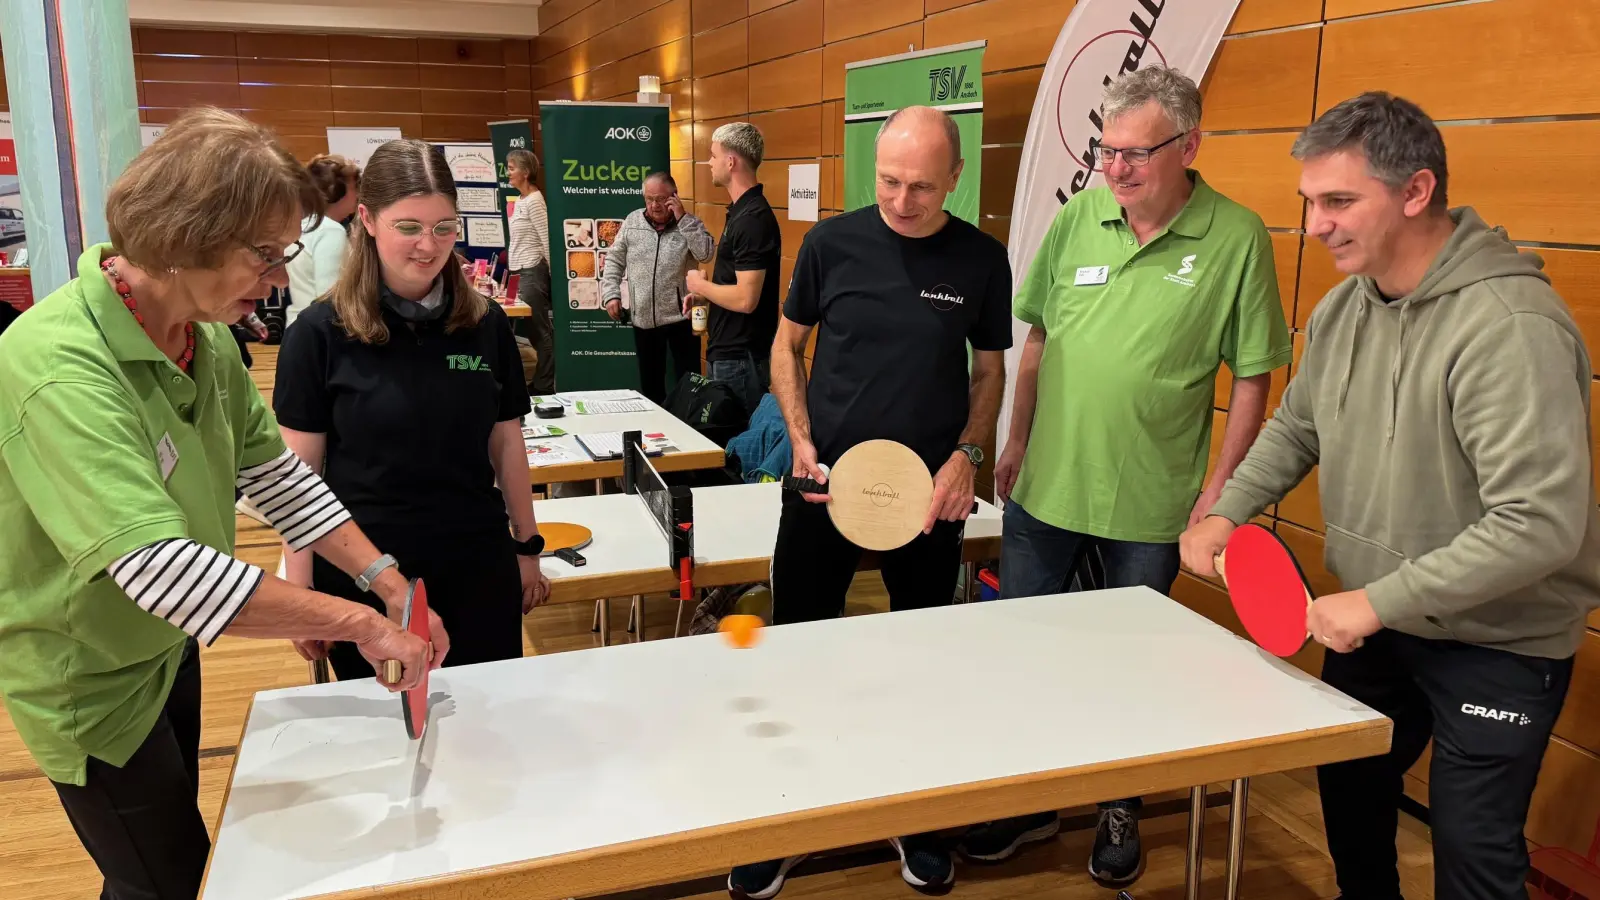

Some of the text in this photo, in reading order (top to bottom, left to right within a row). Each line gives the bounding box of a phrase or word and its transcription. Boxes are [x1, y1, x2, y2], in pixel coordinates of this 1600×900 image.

[929, 65, 967, 102] TSV
[604, 127, 636, 140] AOK
[562, 159, 652, 182] Zucker
[562, 186, 597, 195] Welcher
[598, 186, 610, 195] ist
[790, 187, 817, 200] Aktivitäten
[446, 354, 483, 371] TSV
[1460, 703, 1519, 723] CRAFT
